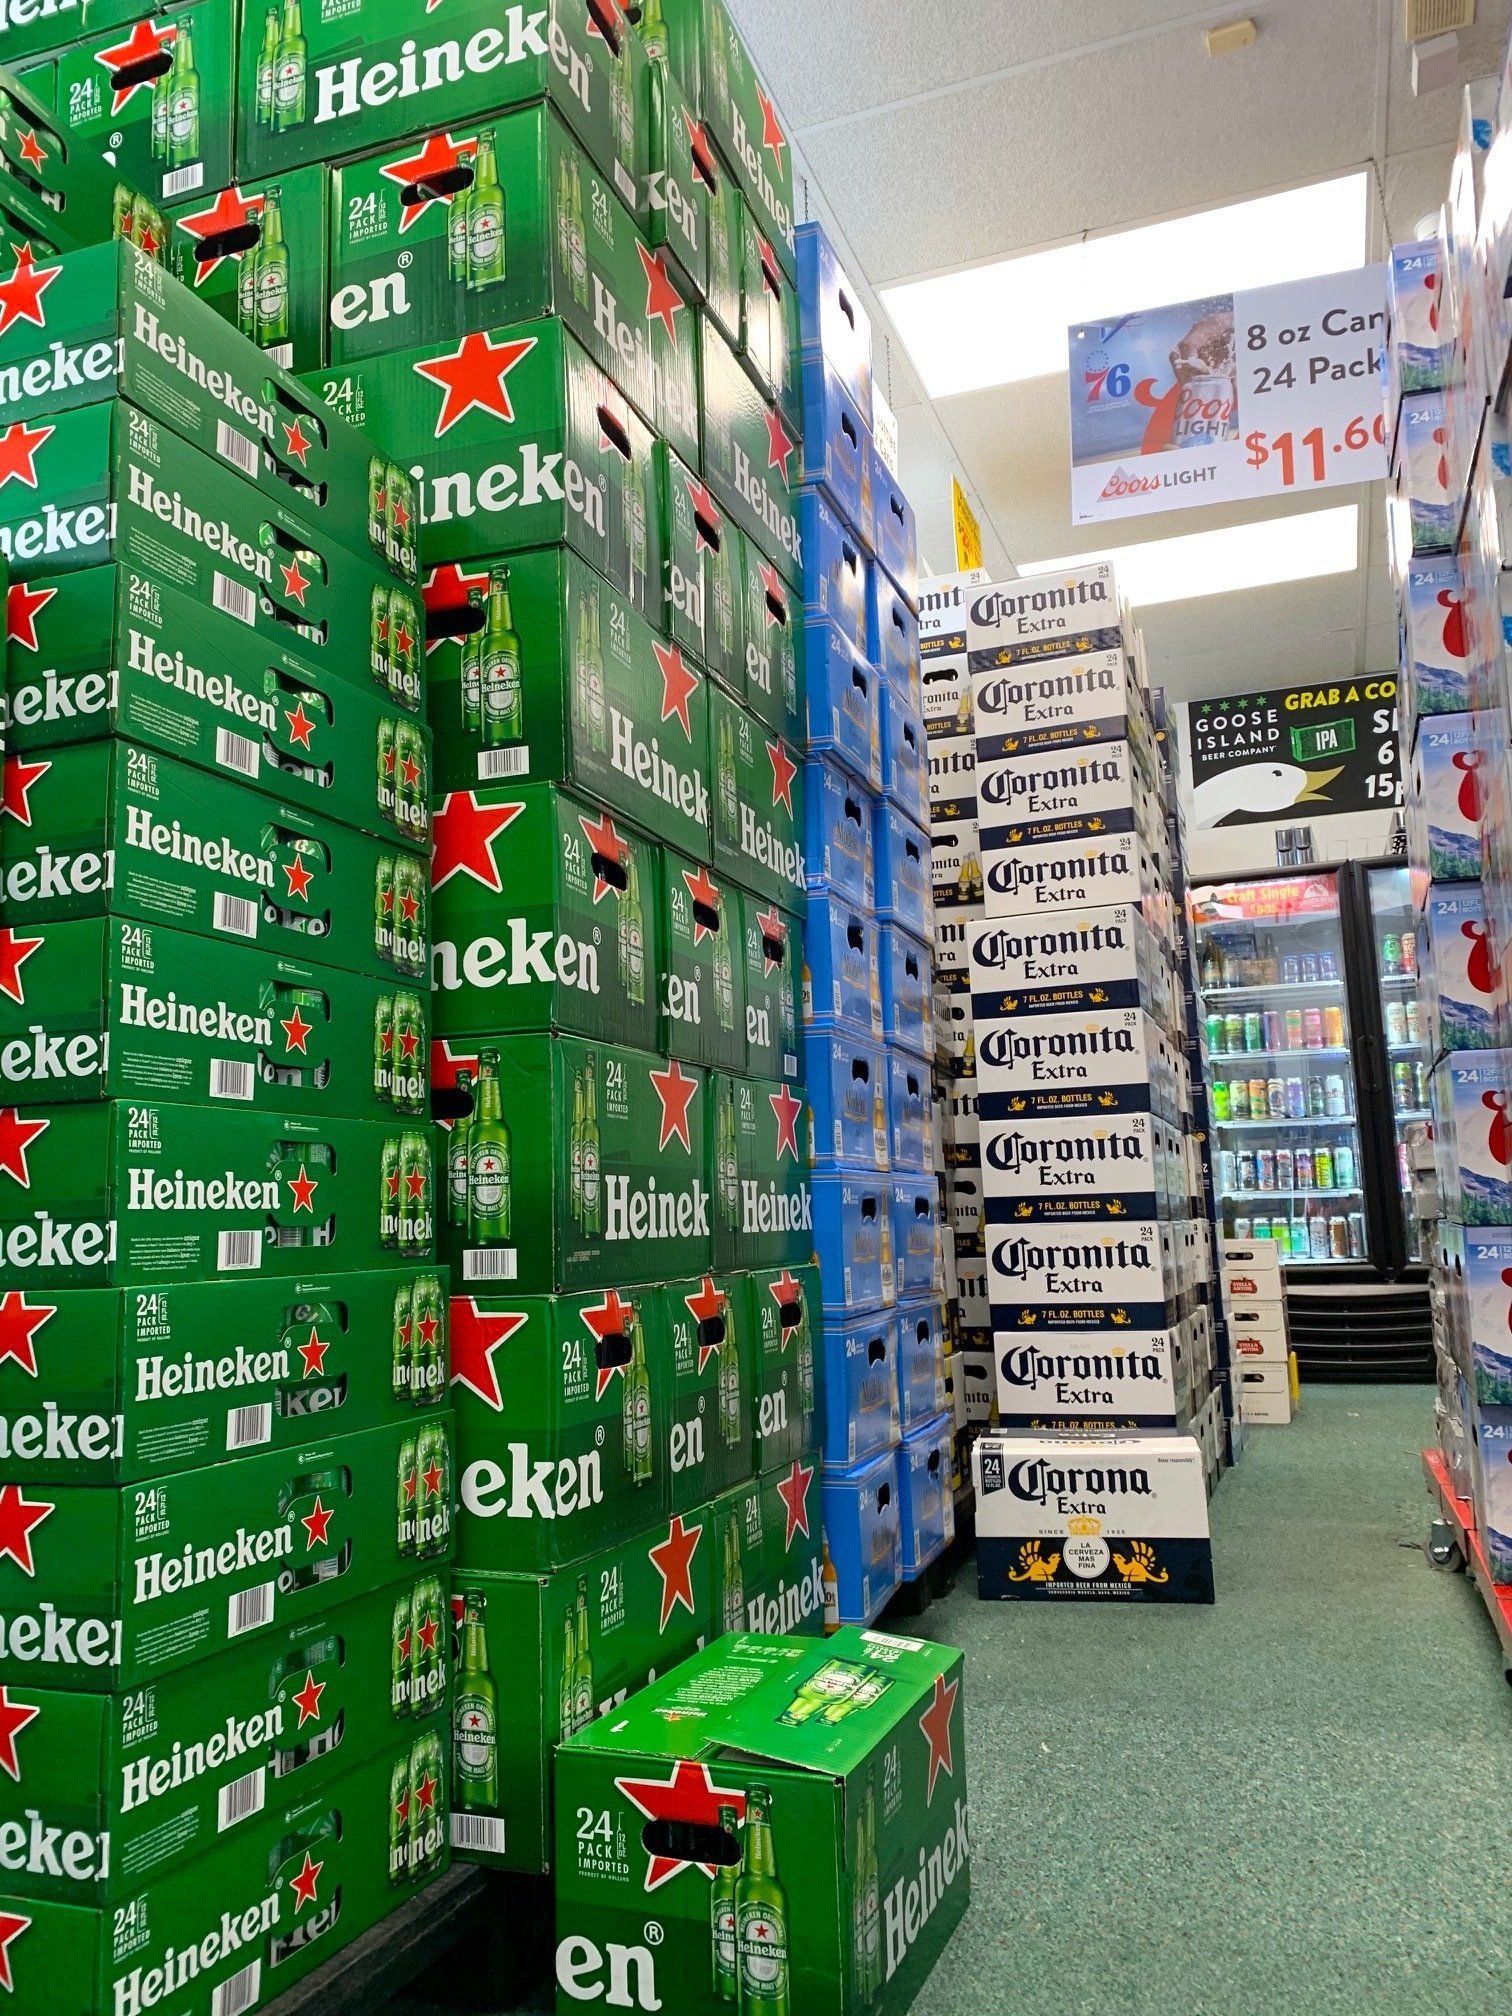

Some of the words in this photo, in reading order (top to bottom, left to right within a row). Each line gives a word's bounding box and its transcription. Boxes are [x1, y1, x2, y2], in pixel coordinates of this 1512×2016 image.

[349, 195, 375, 220] 24
[349, 217, 375, 231] PACK
[349, 222, 388, 240] IMPORTED
[134, 250, 153, 278] 24
[1403, 258, 1423, 271] 24
[1247, 325, 1266, 351] 8
[1278, 323, 1310, 344] oz
[1084, 364, 1131, 403] 76
[1253, 362, 1296, 394] 24
[129, 411, 148, 434] 24
[1410, 411, 1430, 424] 24
[1176, 421, 1228, 437] LIGHT
[1100, 474, 1161, 499] Coors
[1163, 466, 1217, 487] LIGHT
[1097, 565, 1109, 575] 24
[1414, 573, 1435, 587] 24
[129, 574, 150, 597] 24
[970, 579, 1108, 628] Coronita
[1016, 617, 1066, 634] Extra
[1106, 653, 1118, 663] 24
[481, 679, 520, 694] Heineken
[977, 667, 1116, 715] Coronita
[1285, 688, 1340, 711] GRAB
[1345, 685, 1360, 703] A
[1024, 703, 1074, 721] Extra
[1195, 709, 1278, 732] GOOSE
[1050, 728, 1078, 740] BOTTLES
[1198, 728, 1280, 750] ISLAND
[1316, 728, 1338, 751] IPA
[1429, 735, 1449, 747] 24
[127, 749, 147, 770] 24
[1110, 745, 1122, 754] 24
[1202, 750, 1225, 761] BEER
[1228, 745, 1275, 758] COMPANY
[1377, 740, 1394, 765] 6
[610, 708, 709, 828] Heinek
[981, 760, 1121, 806] Coronita
[1028, 797, 1078, 813] Extra
[563, 833, 582, 861] 24
[740, 802, 807, 891] Heinek
[1119, 837, 1131, 847] 24
[987, 852, 1129, 895] Coronita
[1036, 886, 1086, 904] Extra
[1114, 909, 1126, 919] 24
[1437, 901, 1458, 914] 24
[121, 925, 142, 947] 24
[972, 925, 1126, 970] Coronita
[1023, 961, 1079, 980] Extra
[1052, 990, 1083, 1001] BOTTLES
[1124, 1012, 1136, 1022] 24
[980, 1026, 1136, 1070] Coronita
[606, 1060, 623, 1087] 24
[1032, 1061, 1088, 1080] Extra
[1457, 1068, 1478, 1083] 24
[606, 1089, 623, 1102] PACK
[1061, 1093, 1092, 1103] BOTTLES
[128, 1108, 148, 1129] 24
[606, 1103, 629, 1114] IMPORTED
[1132, 1118, 1145, 1128] 24
[128, 1129, 148, 1139] PACK
[128, 1139, 162, 1150] IMPORTED
[986, 1131, 1144, 1175] Coronita
[468, 1174, 511, 1186] Heineken
[1039, 1165, 1095, 1186] Extra
[605, 1174, 710, 1240] Heinek
[742, 1179, 813, 1234] Heinek
[1069, 1200, 1100, 1210] BOTTLES
[1140, 1226, 1153, 1236] 24
[991, 1237, 1151, 1281] Coronita
[1476, 1245, 1500, 1260] 24
[1046, 1273, 1103, 1294] Extra
[137, 1294, 157, 1316] 24
[1073, 1309, 1105, 1318] BOTTLES
[1151, 1337, 1165, 1347] 24
[562, 1341, 582, 1371] 24
[1000, 1345, 1163, 1390] Coronita
[1056, 1383, 1114, 1405] Extra
[984, 1458, 1000, 1474] 24
[1008, 1457, 1152, 1506] Corona
[135, 1489, 156, 1516] 24
[1057, 1496, 1106, 1515] Extra
[601, 1566, 619, 1601] 24
[748, 1557, 825, 1635] Heinek
[123, 1691, 144, 1719] 24
[453, 1730, 497, 1744] Heineken
[577, 1808, 613, 1842] 24
[578, 1841, 613, 1859] PACK
[578, 1857, 629, 1874] IMPORTED
[884, 1799, 969, 1981] Heinek
[114, 1901, 137, 1934] 24
[737, 1940, 787, 1960] Heineken
